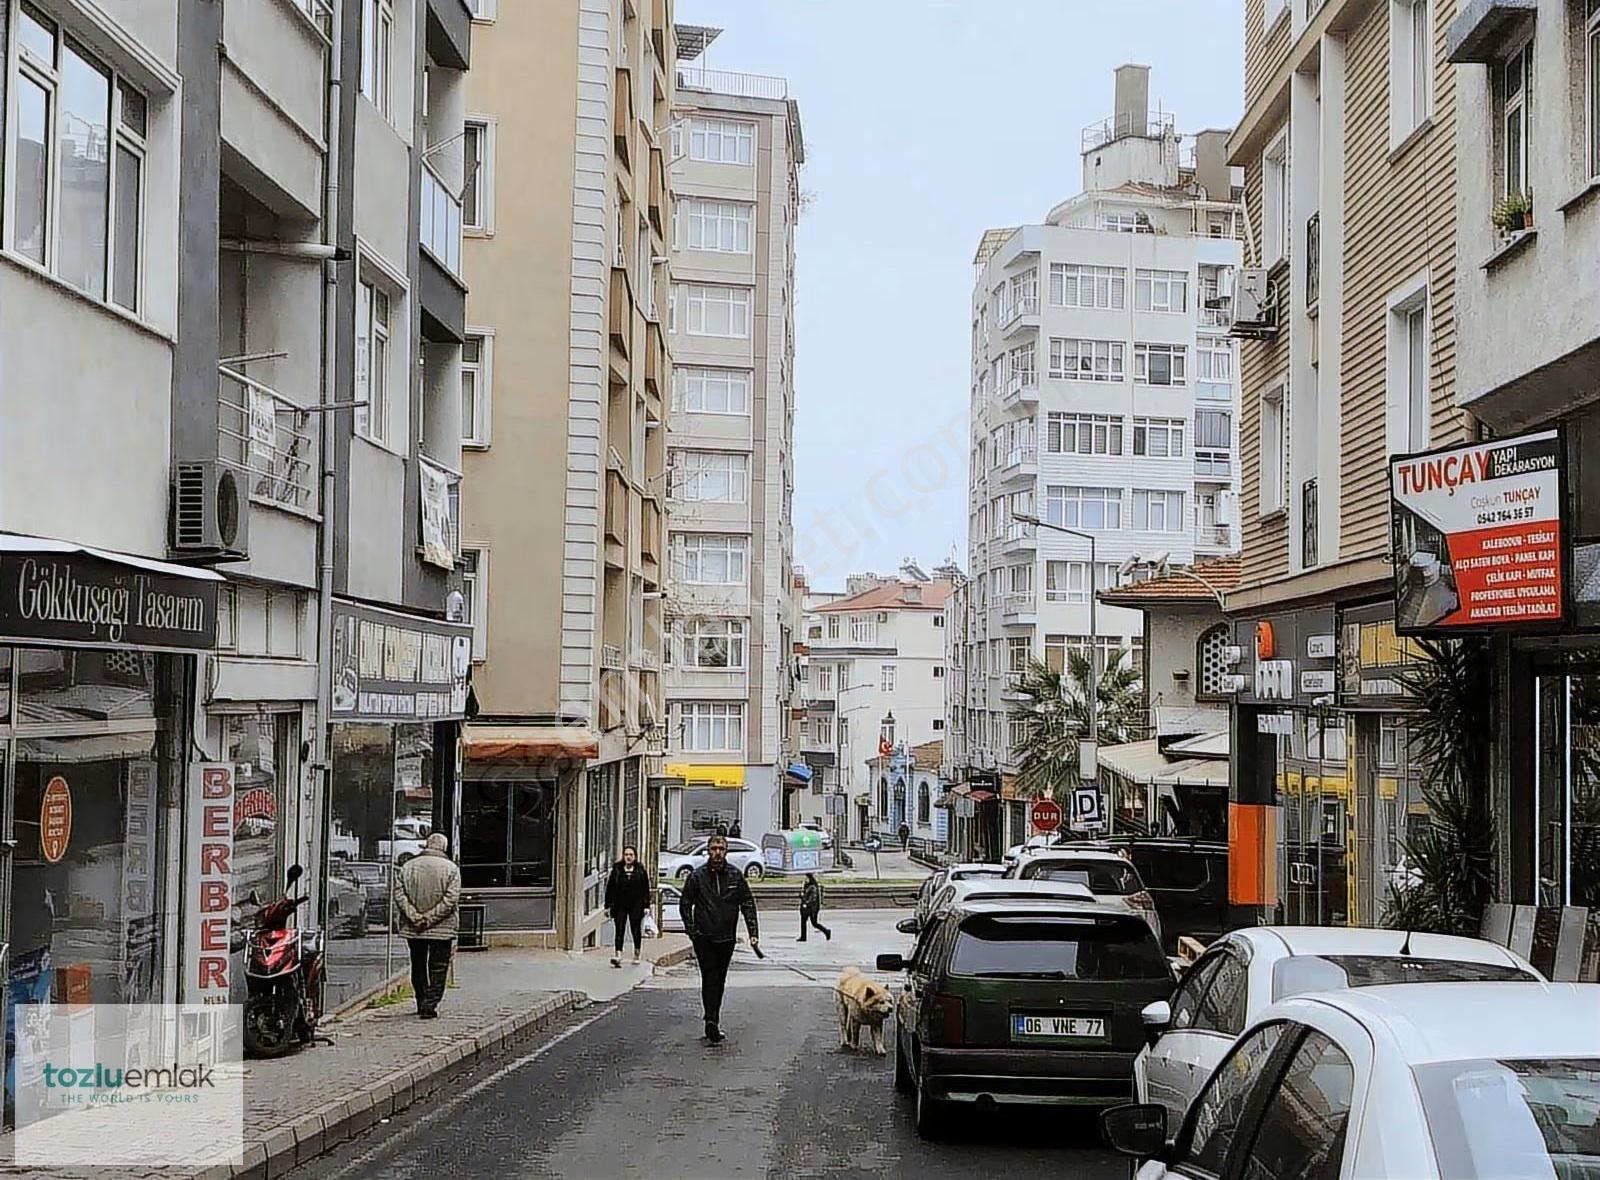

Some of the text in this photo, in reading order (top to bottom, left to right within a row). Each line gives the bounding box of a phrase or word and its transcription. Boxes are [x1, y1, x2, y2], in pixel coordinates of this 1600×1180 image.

[1492, 446, 1517, 464] YAPI
[1398, 449, 1491, 497] TUNÇAY
[1503, 486, 1541, 504] TUNÇAY
[18, 558, 204, 642] Gökkuşağı Tasarım
[1033, 811, 1058, 821] DUR
[198, 768, 232, 988] BERBER
[1025, 1018, 1102, 1035] 06 VNE 77
